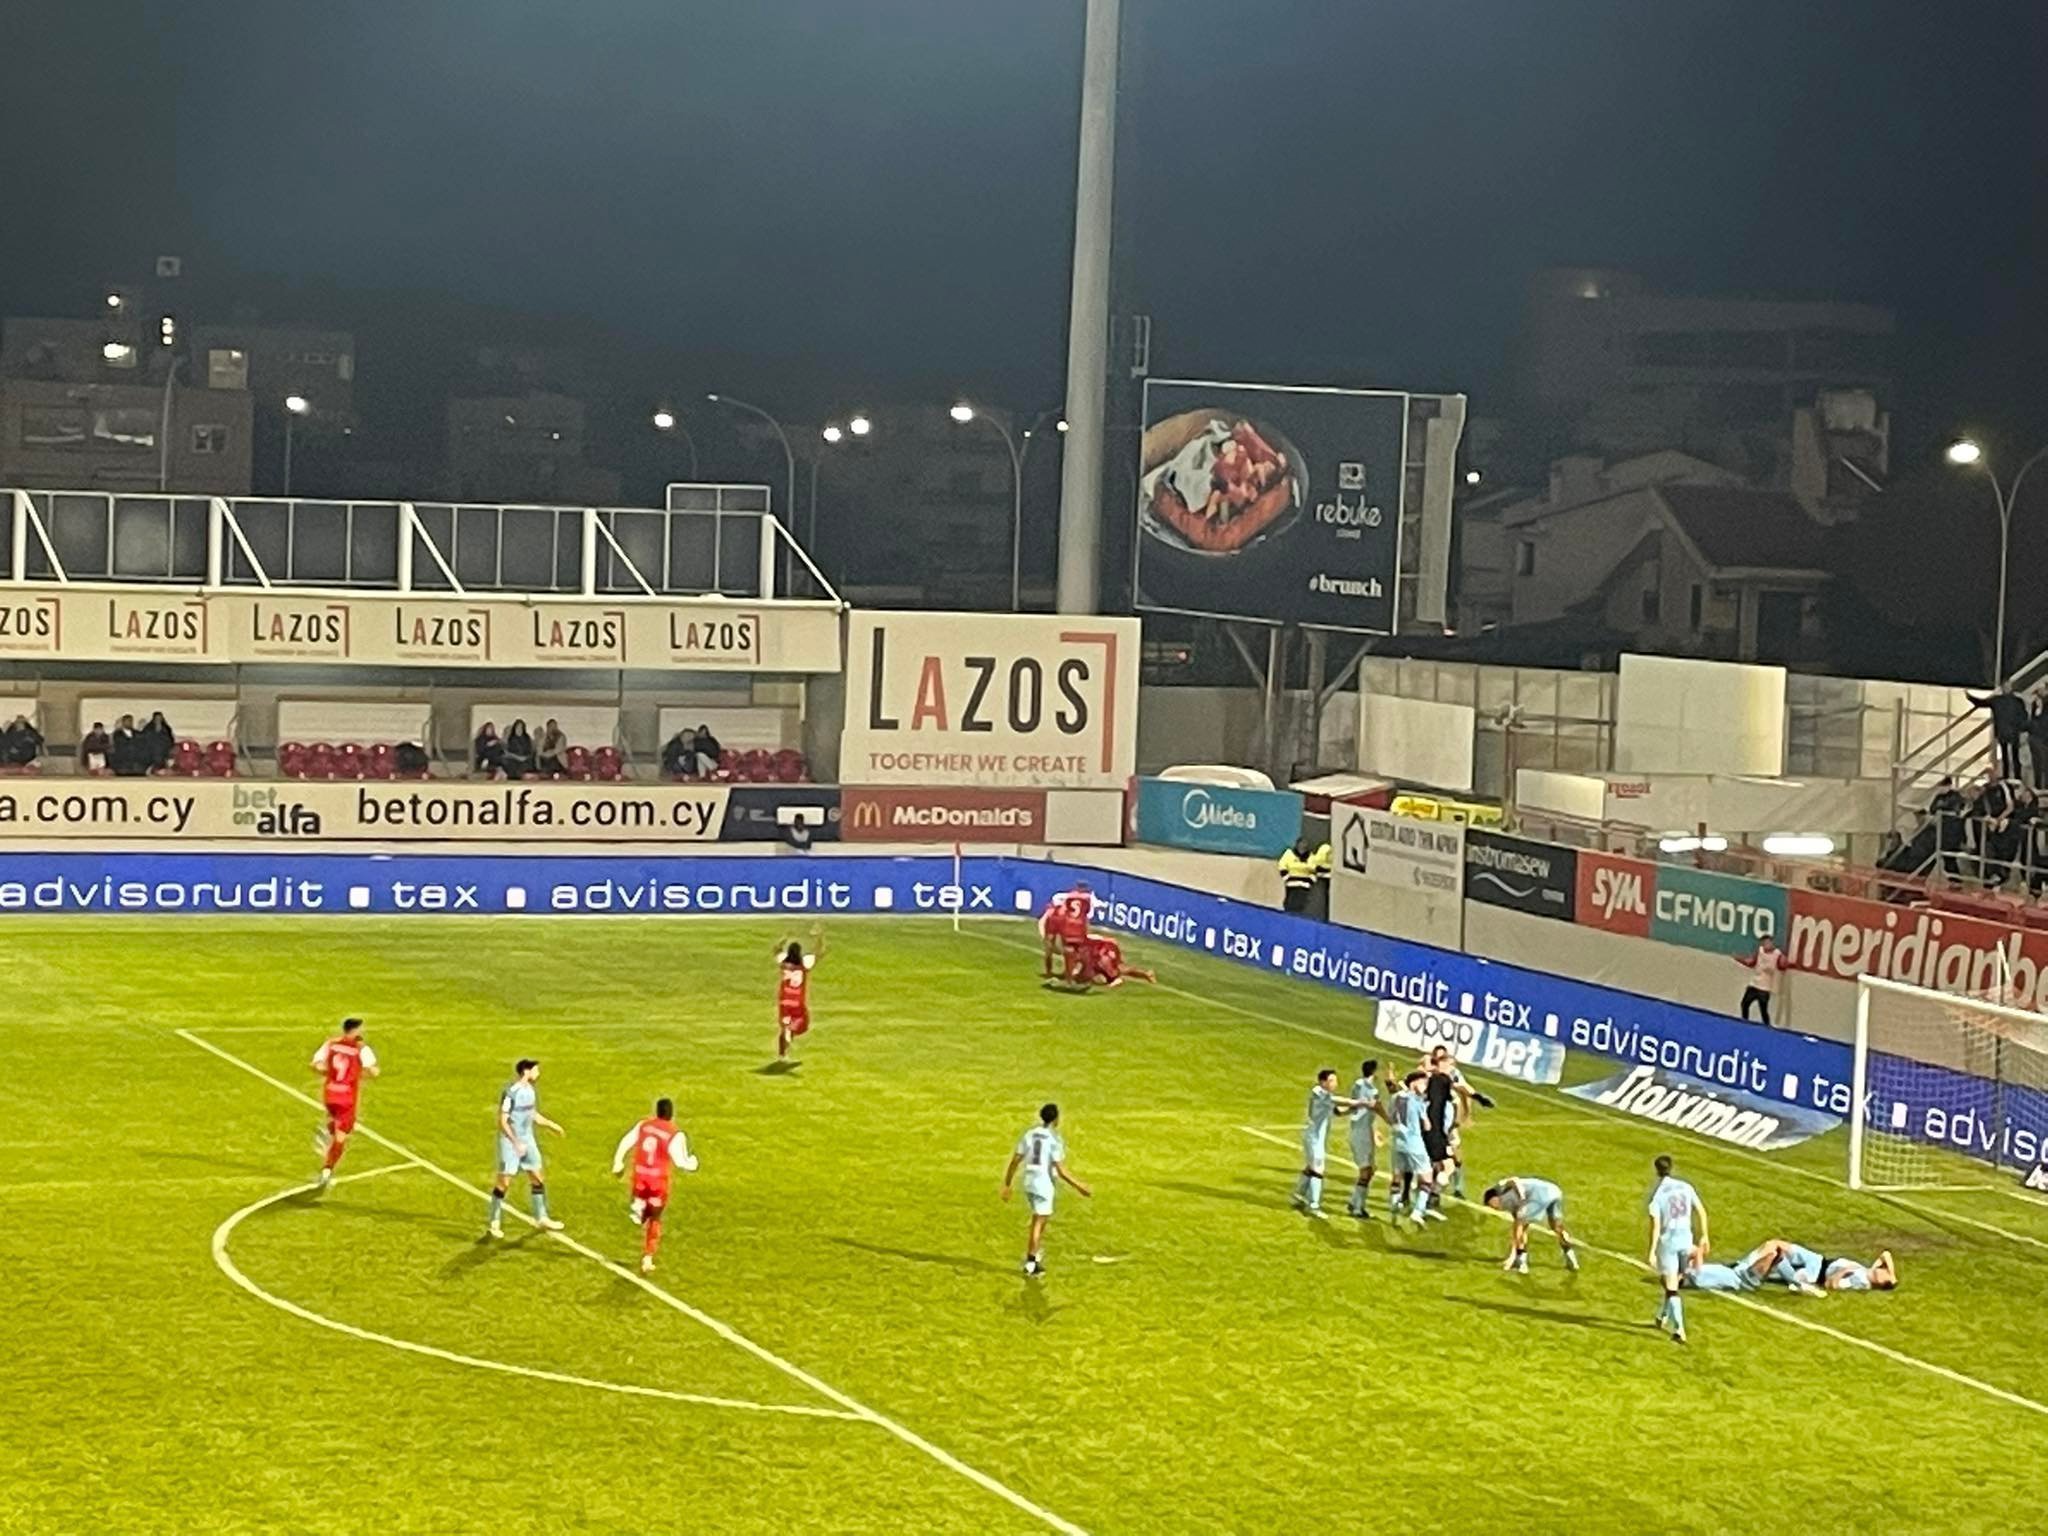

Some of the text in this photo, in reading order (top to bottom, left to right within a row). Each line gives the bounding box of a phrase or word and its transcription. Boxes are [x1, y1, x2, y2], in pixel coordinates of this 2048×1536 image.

[109, 599, 198, 640] LAZOS
[254, 603, 340, 643] LAZOS
[396, 607, 480, 647] LAZOS
[534, 611, 616, 649] LAZOS
[670, 612, 751, 650] LAZOS
[869, 627, 1089, 734] LAZOS
[869, 753, 1087, 773] TOGETHER WE CREATE
[233, 785, 277, 809] bet
[358, 788, 716, 835] betonalfa.com.cy
[893, 805, 1033, 826] McDonald's
[257, 804, 320, 835] alfa
[0, 875, 993, 910] advisorudit tax advisorudit tax
[1592, 868, 1647, 920] SYM
[1656, 890, 1775, 939] CFMOTO
[1223, 927, 1262, 961] tax
[1292, 947, 1449, 1009] advisorudit
[1484, 992, 1532, 1030] tax
[1571, 1017, 1767, 1092] advisorudit
[1406, 1010, 1473, 1057] opap
[1482, 1023, 1543, 1083] bet
[1595, 1065, 1780, 1150] Stoiximan
